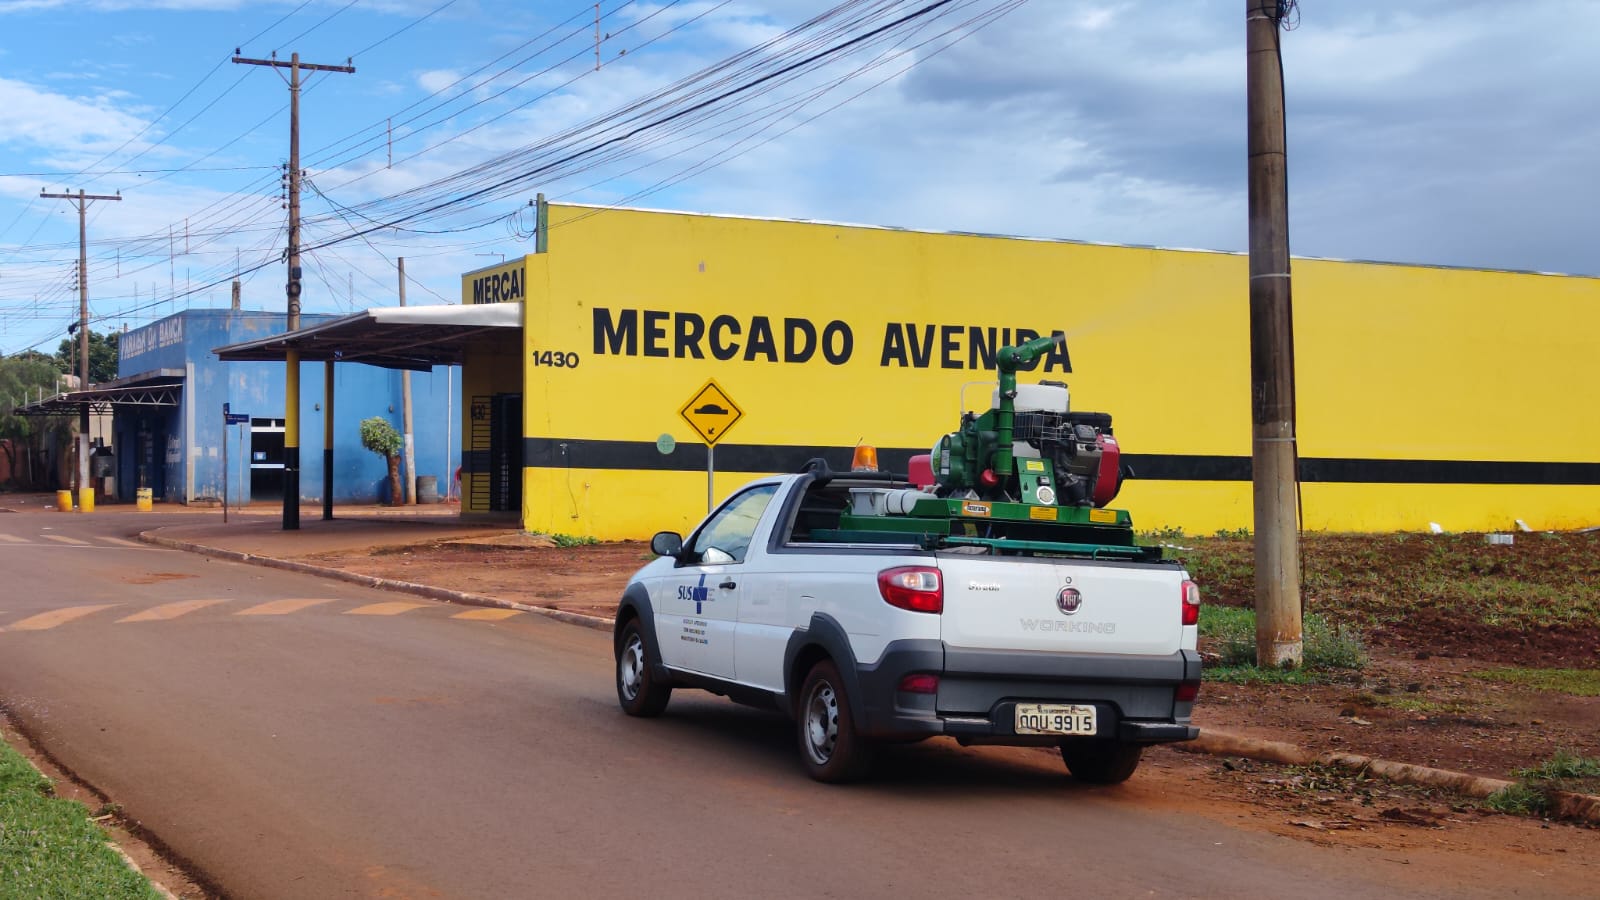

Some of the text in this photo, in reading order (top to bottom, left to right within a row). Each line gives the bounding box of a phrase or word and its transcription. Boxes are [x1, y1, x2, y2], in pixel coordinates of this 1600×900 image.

[473, 267, 525, 305] MERCA
[593, 307, 854, 366] MERCADO
[532, 350, 580, 369] 1430
[677, 585, 693, 601] SUS
[1063, 594, 1078, 606] FIAT
[1020, 618, 1116, 634] WORKING
